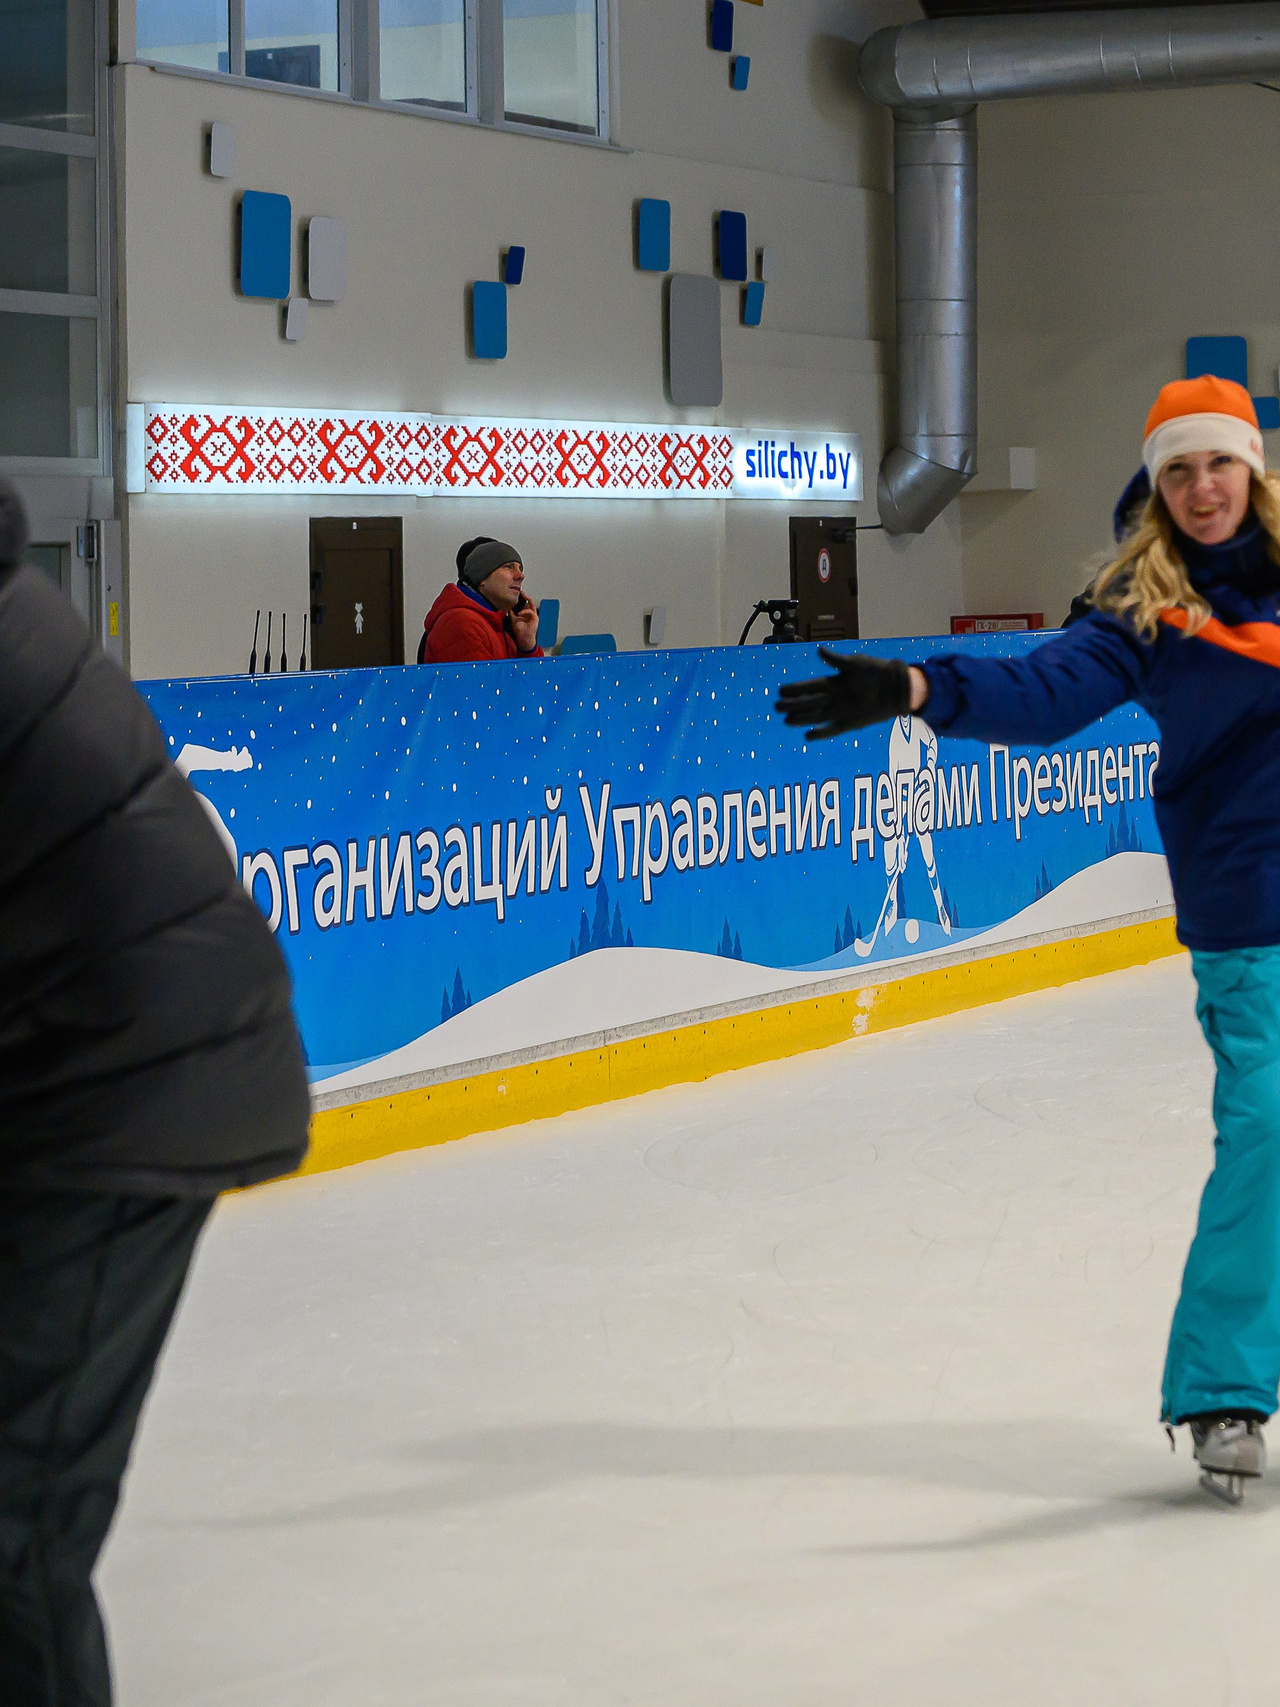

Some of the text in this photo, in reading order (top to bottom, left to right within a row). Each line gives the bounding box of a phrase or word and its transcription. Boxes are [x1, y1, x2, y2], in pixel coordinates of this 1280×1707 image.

[746, 440, 851, 489] silichy.by
[579, 780, 841, 902] Управления
[852, 764, 982, 861] делами
[989, 741, 1160, 840] Президента
